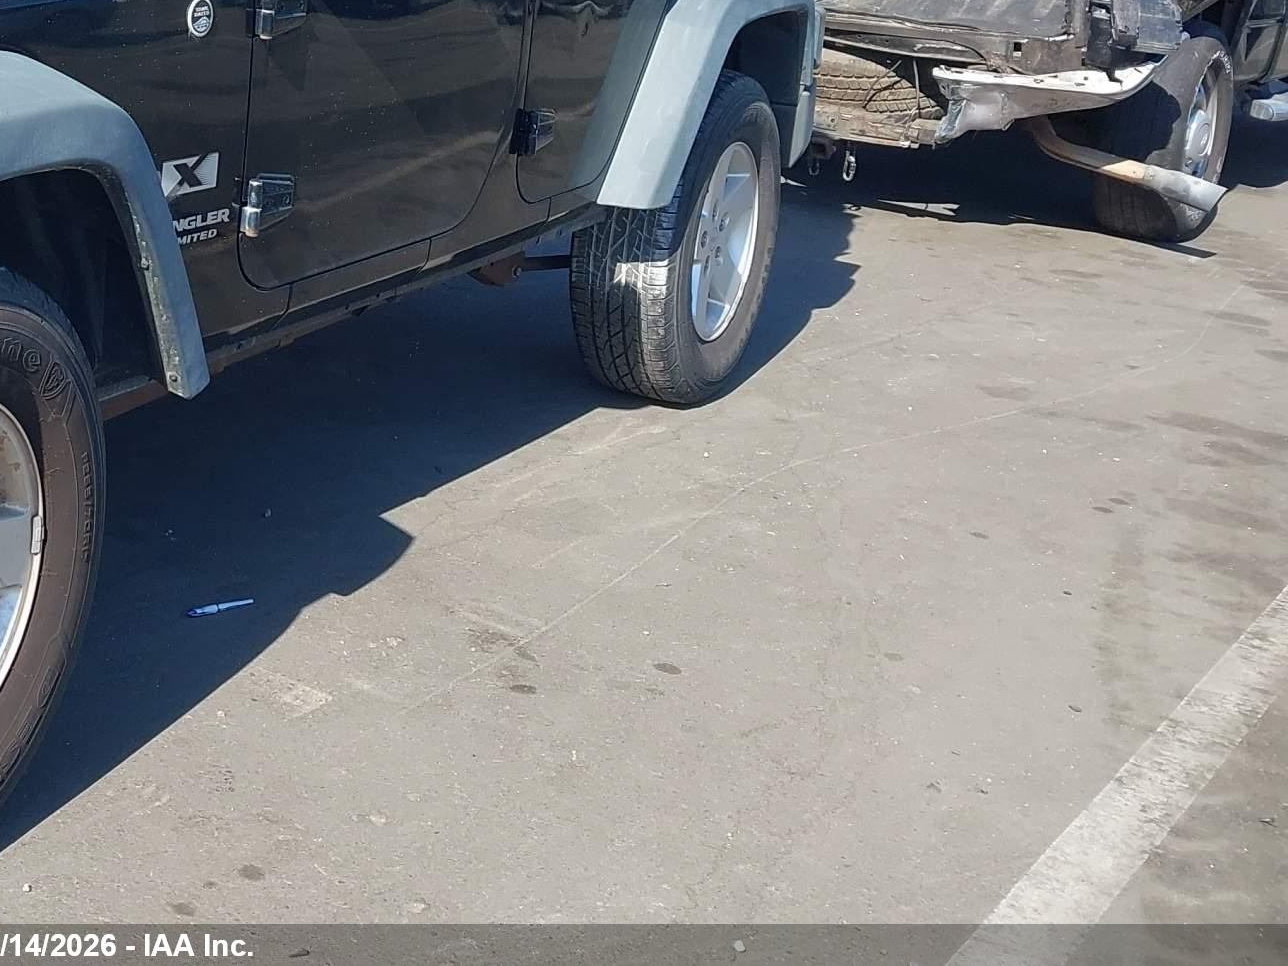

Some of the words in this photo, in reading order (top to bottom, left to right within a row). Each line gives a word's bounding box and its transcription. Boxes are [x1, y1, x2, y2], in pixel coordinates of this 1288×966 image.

[165, 152, 211, 201] X
[172, 208, 231, 232] NGLER
[177, 228, 218, 246] MITED
